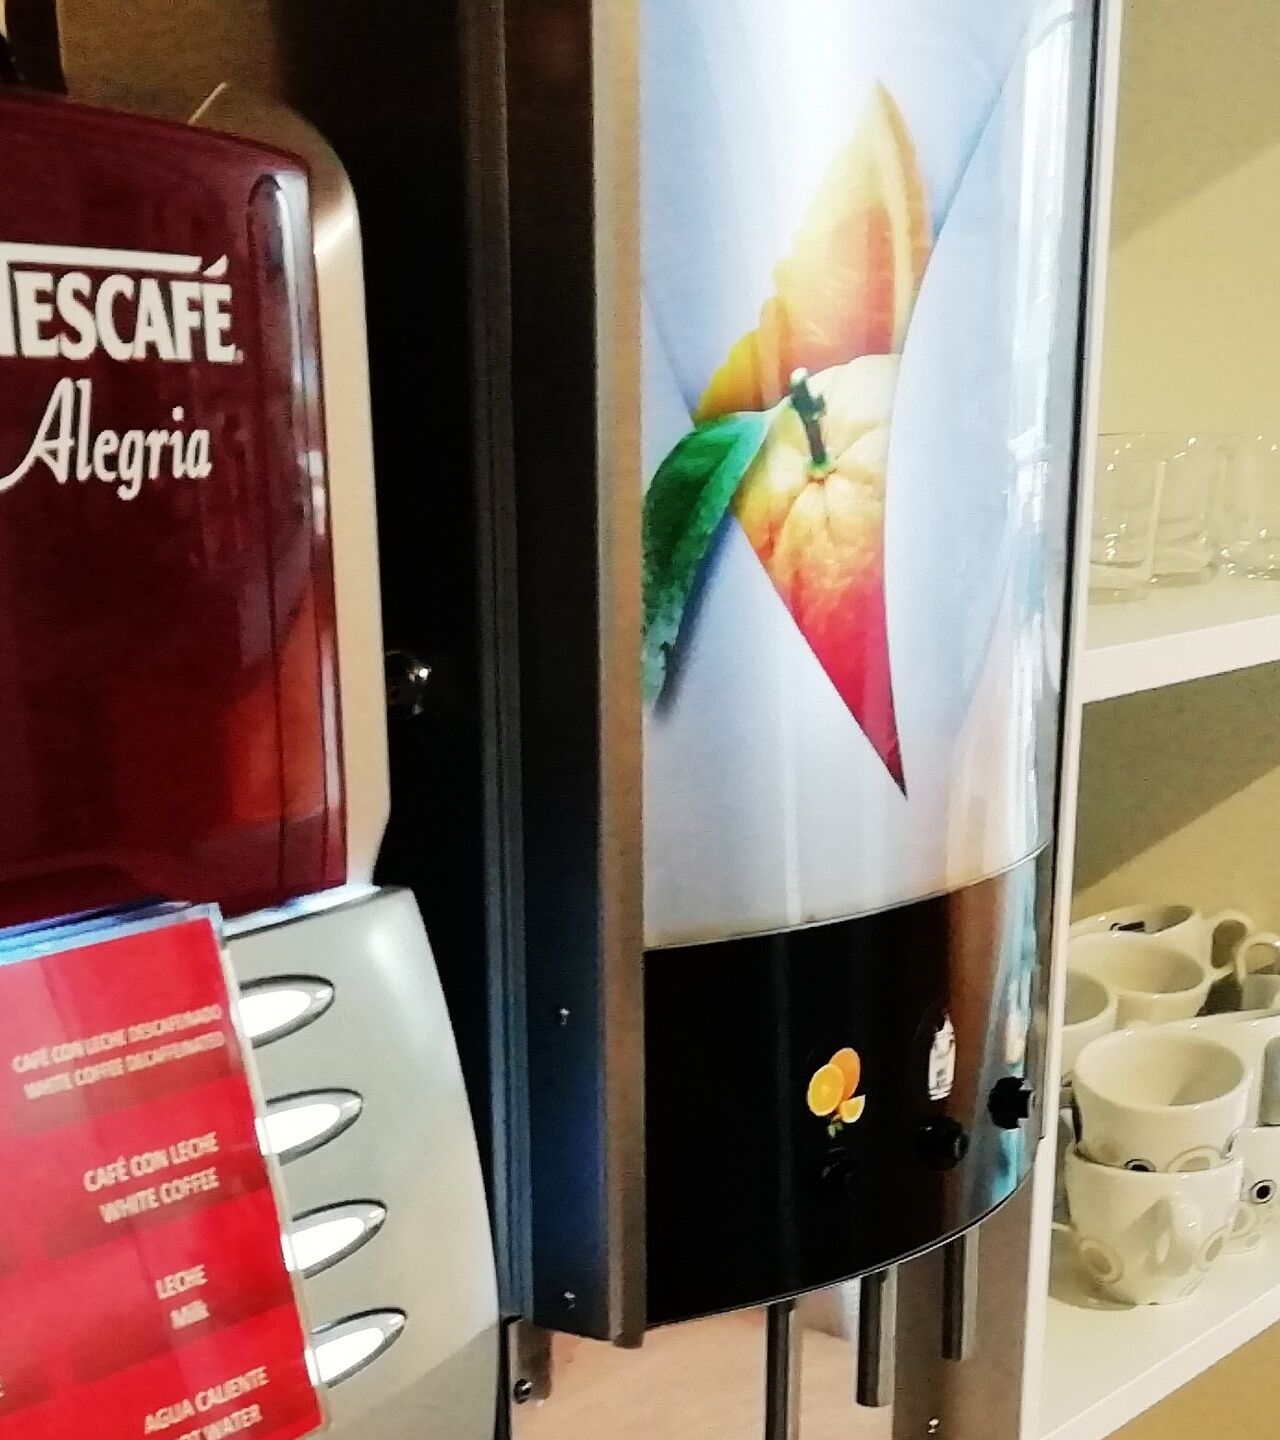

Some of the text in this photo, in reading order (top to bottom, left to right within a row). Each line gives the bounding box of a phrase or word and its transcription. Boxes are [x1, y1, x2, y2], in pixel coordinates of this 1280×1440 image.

[83, 1131, 220, 1192] CAFÉ CON LECHE
[98, 1167, 219, 1223] WHITE COFFEE
[156, 1264, 209, 1300] LECHE
[143, 1366, 270, 1434] AGUA CALIENTE
